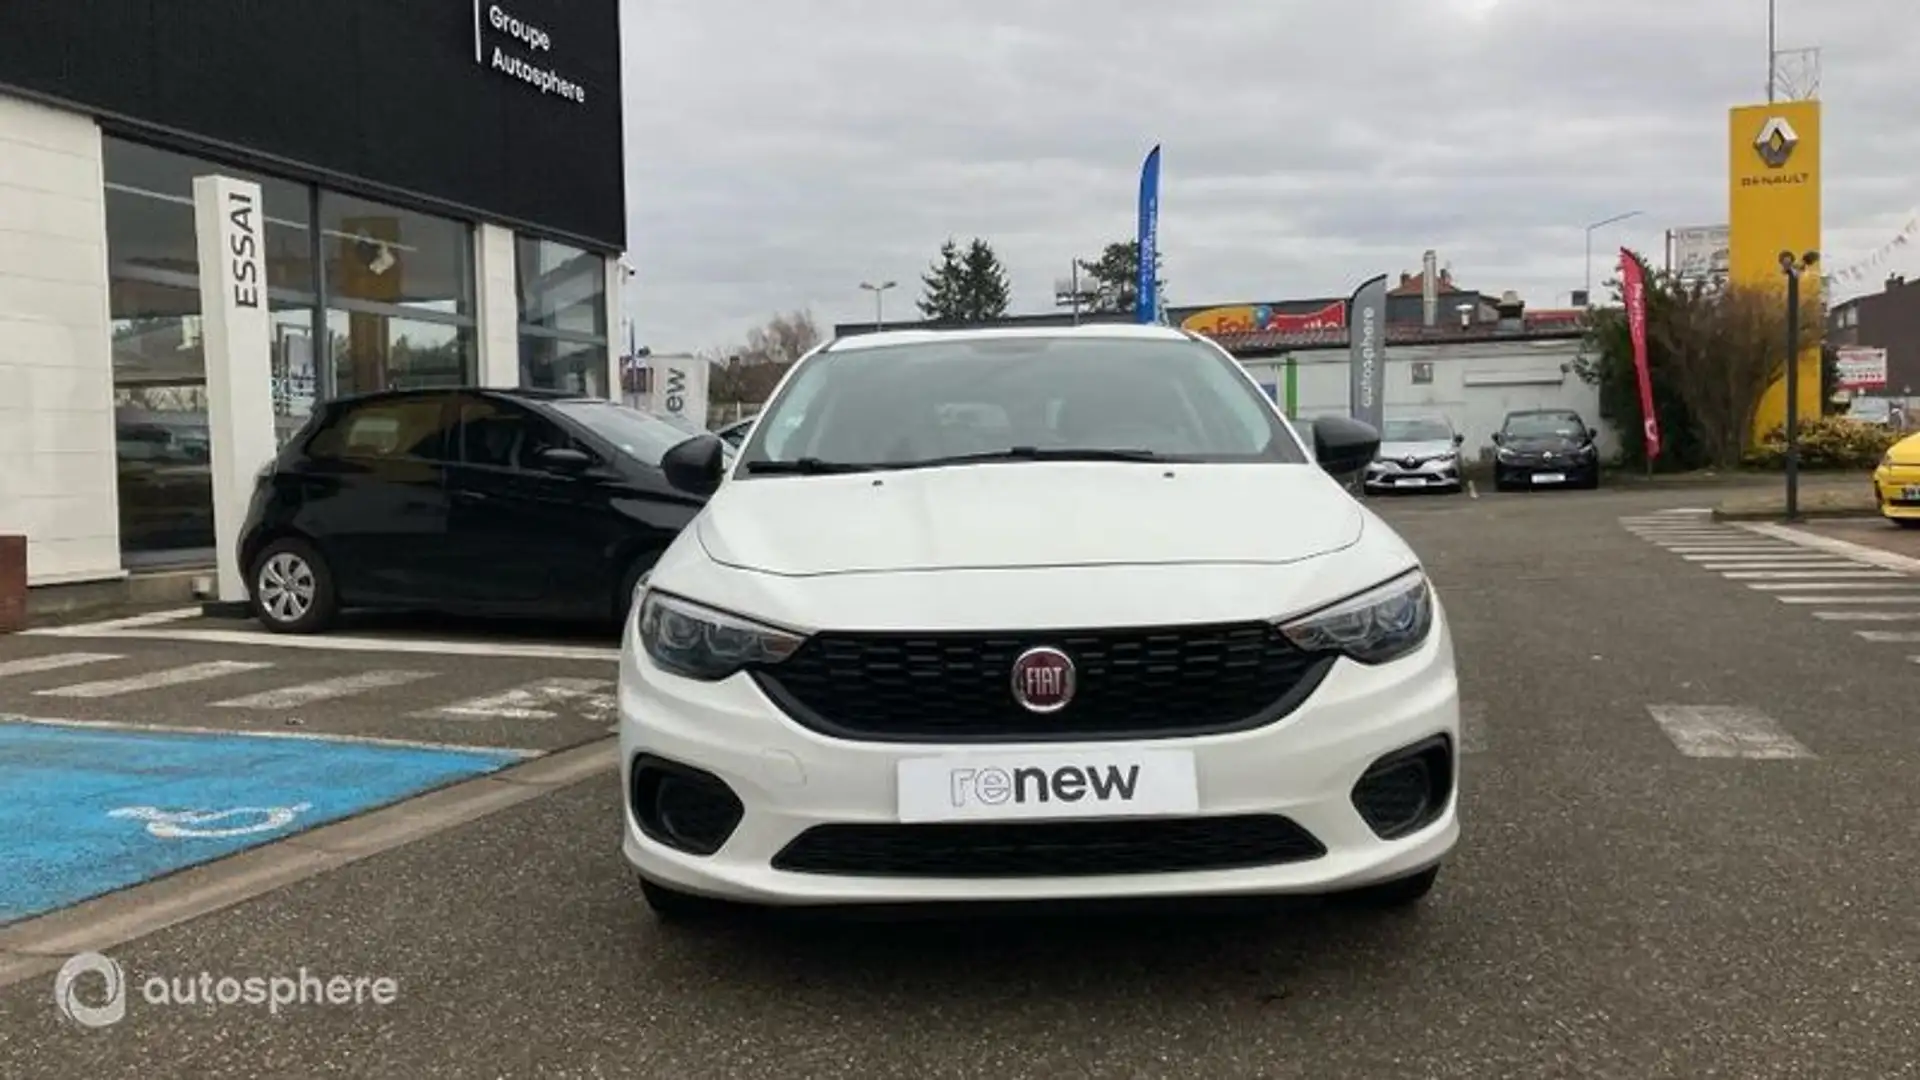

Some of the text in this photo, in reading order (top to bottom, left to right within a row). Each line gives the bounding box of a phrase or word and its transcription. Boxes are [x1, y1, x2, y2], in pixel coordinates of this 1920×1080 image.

[490, 5, 549, 51] Groupe
[492, 46, 585, 103] Autosphere
[1741, 172, 1808, 188] RENAULT
[229, 192, 258, 309] ESSAI
[1026, 667, 1062, 695] FIAT
[951, 764, 1140, 808] renew
